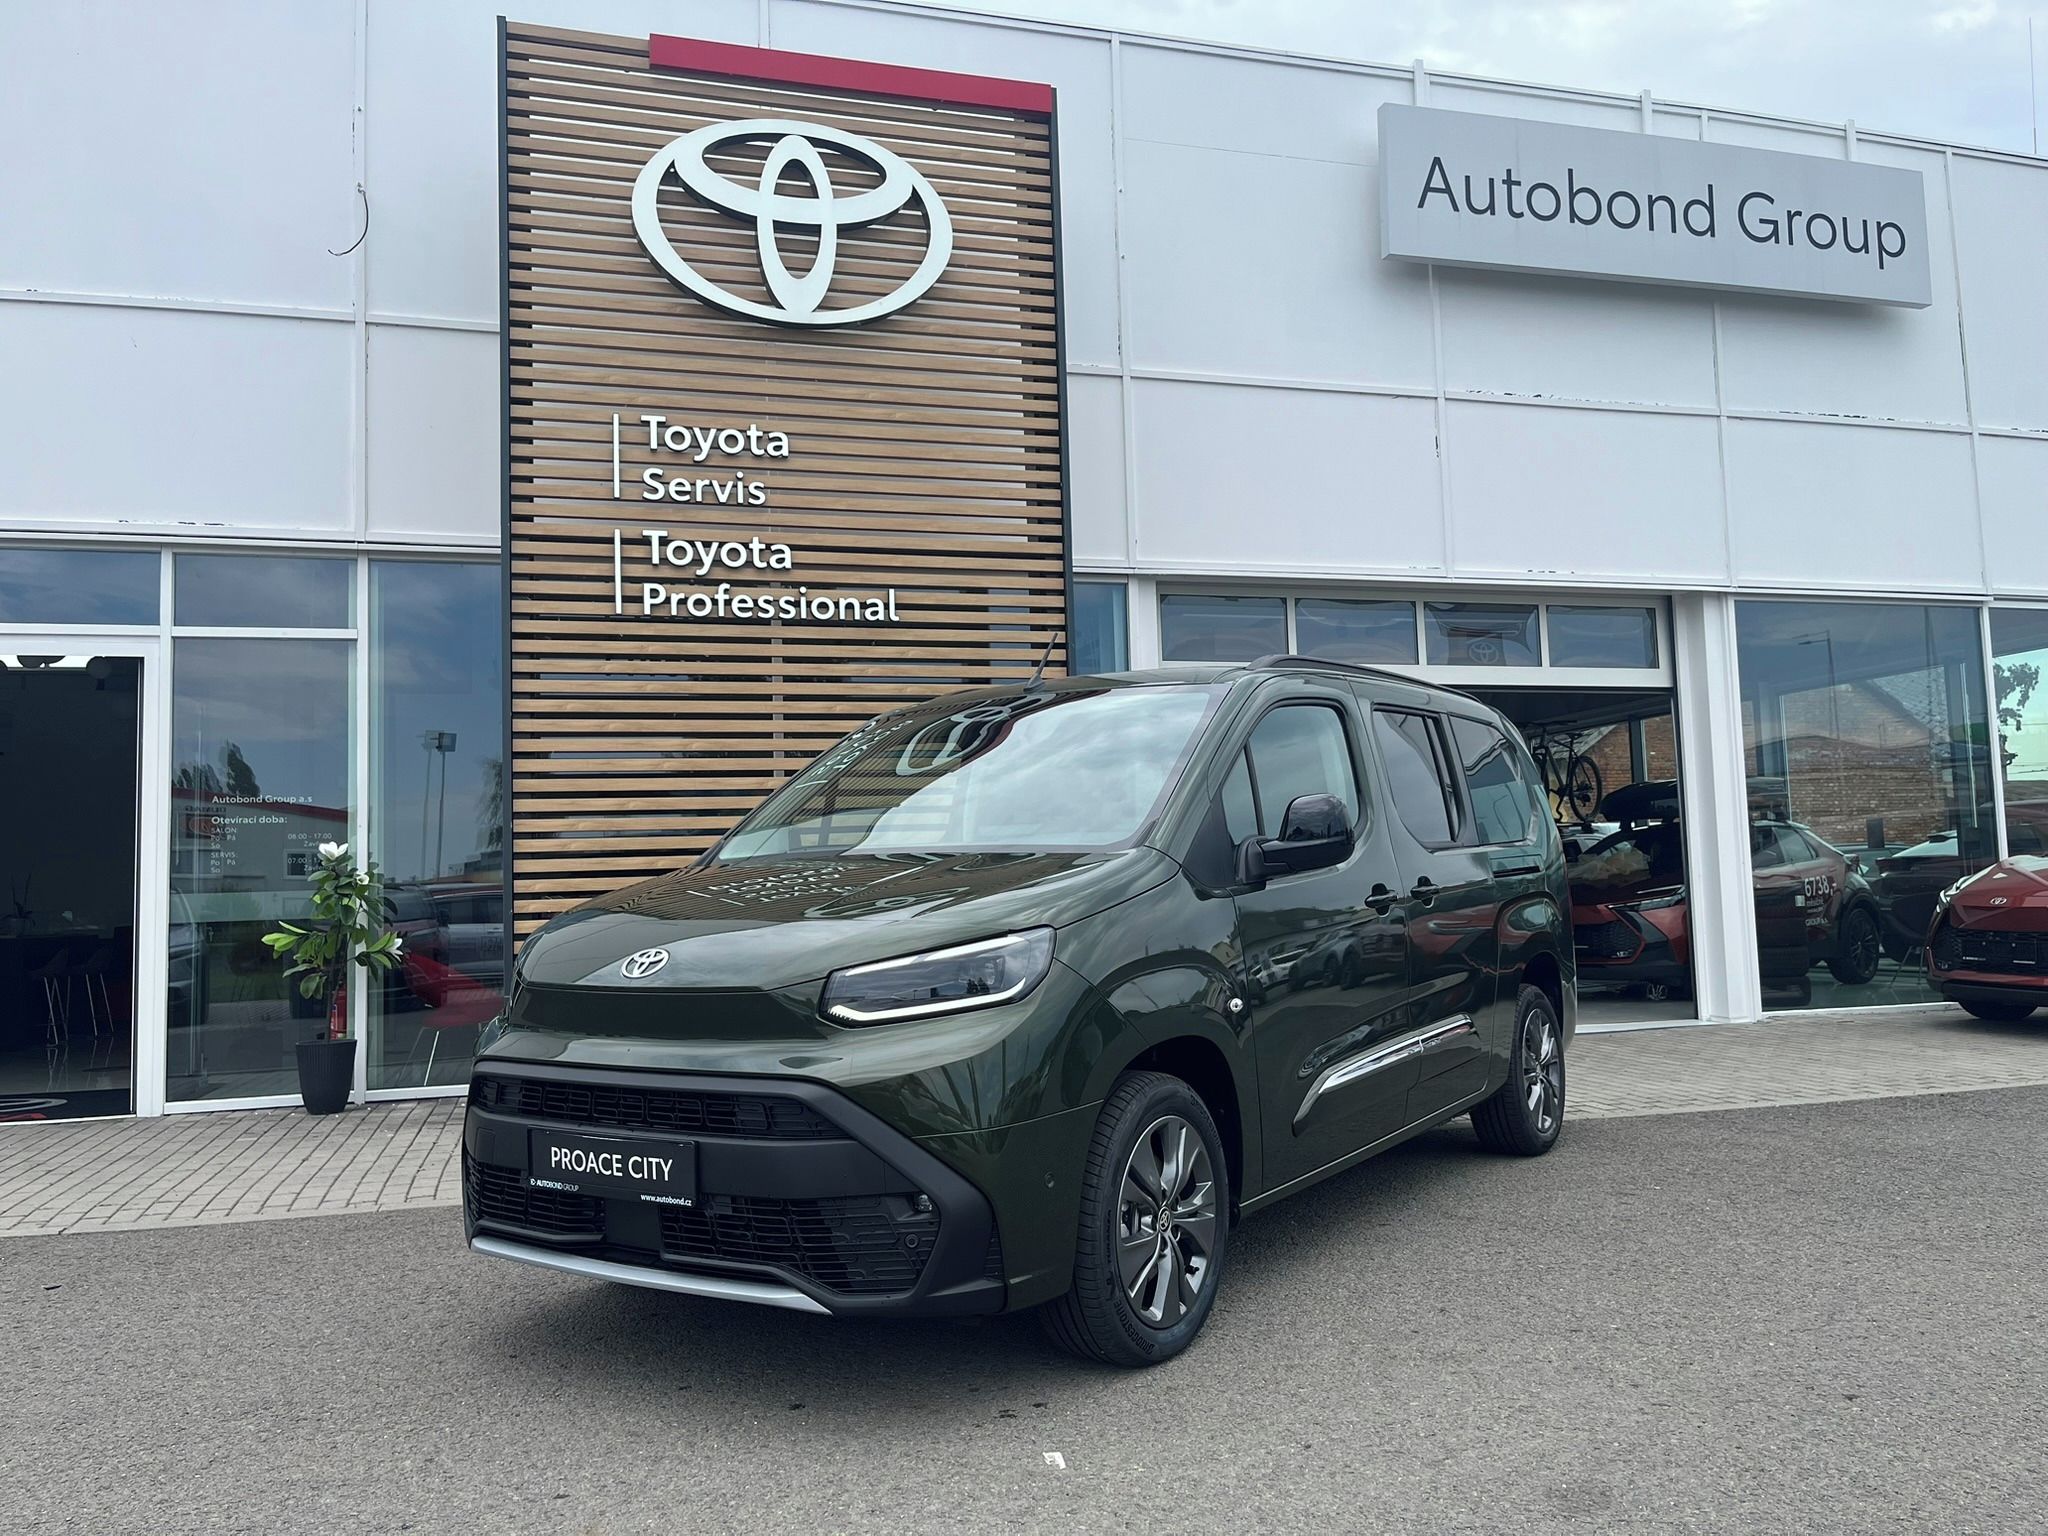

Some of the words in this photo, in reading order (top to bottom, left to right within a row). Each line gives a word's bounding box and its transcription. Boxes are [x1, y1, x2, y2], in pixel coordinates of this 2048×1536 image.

[1417, 155, 1717, 239] Autobond
[1736, 190, 1907, 270] Group
[640, 414, 790, 463] Toyota
[642, 467, 767, 506] Servis
[642, 529, 793, 577] Toyota
[643, 582, 900, 622] Professional
[211, 795, 263, 804] Autobond
[265, 795, 297, 805] Group
[211, 815, 257, 825] Otevírací
[258, 815, 288, 824] doba:
[550, 1145, 624, 1177] PROACE
[628, 1155, 673, 1182] CITY
[640, 1193, 693, 1207] www.autobond.cz
[1113, 1299, 1156, 1356] BRIDGESTONE
